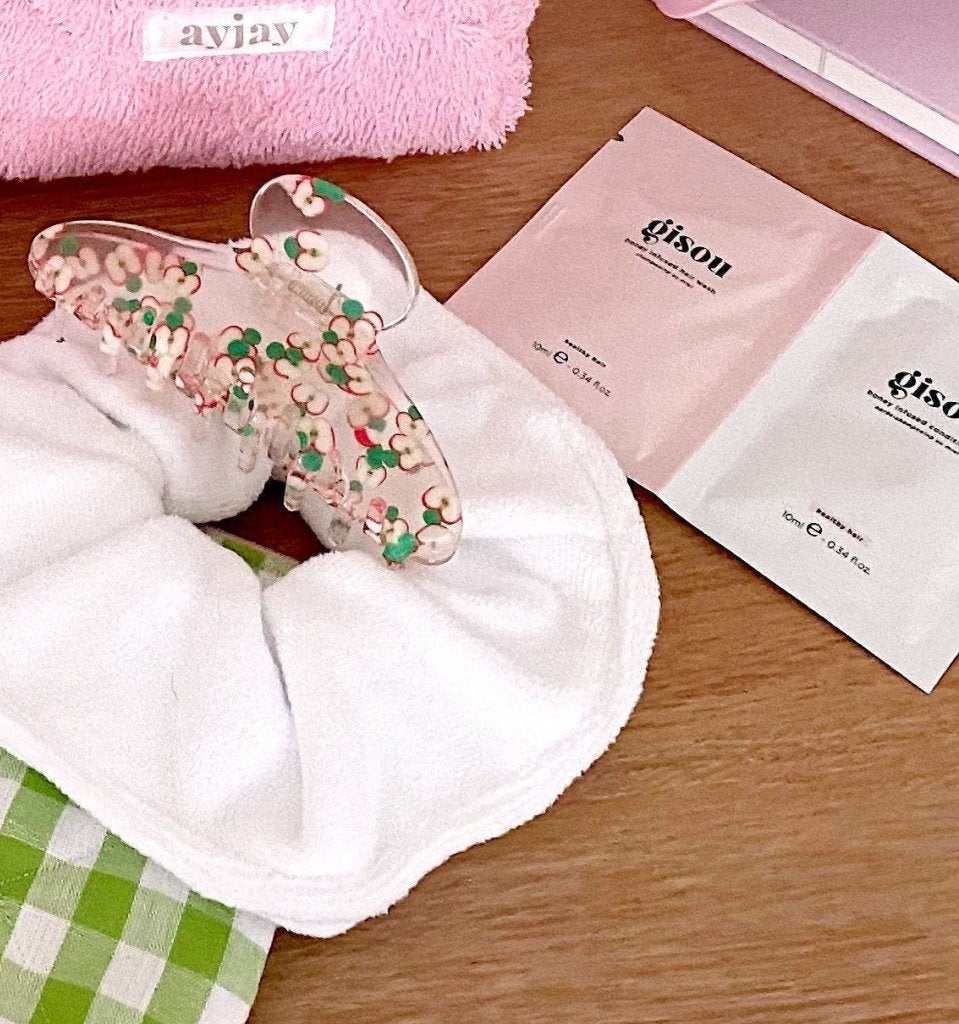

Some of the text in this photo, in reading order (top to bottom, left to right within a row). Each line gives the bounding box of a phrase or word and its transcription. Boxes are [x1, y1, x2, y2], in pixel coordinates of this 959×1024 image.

[180, 13, 298, 49] ayjay
[641, 219, 733, 279] gisou
[867, 389, 893, 407] honey
[895, 405, 928, 426] infused
[782, 510, 805, 530] 10ml
[827, 540, 849, 558] 0.34
[816, 508, 864, 542] healthy hair
